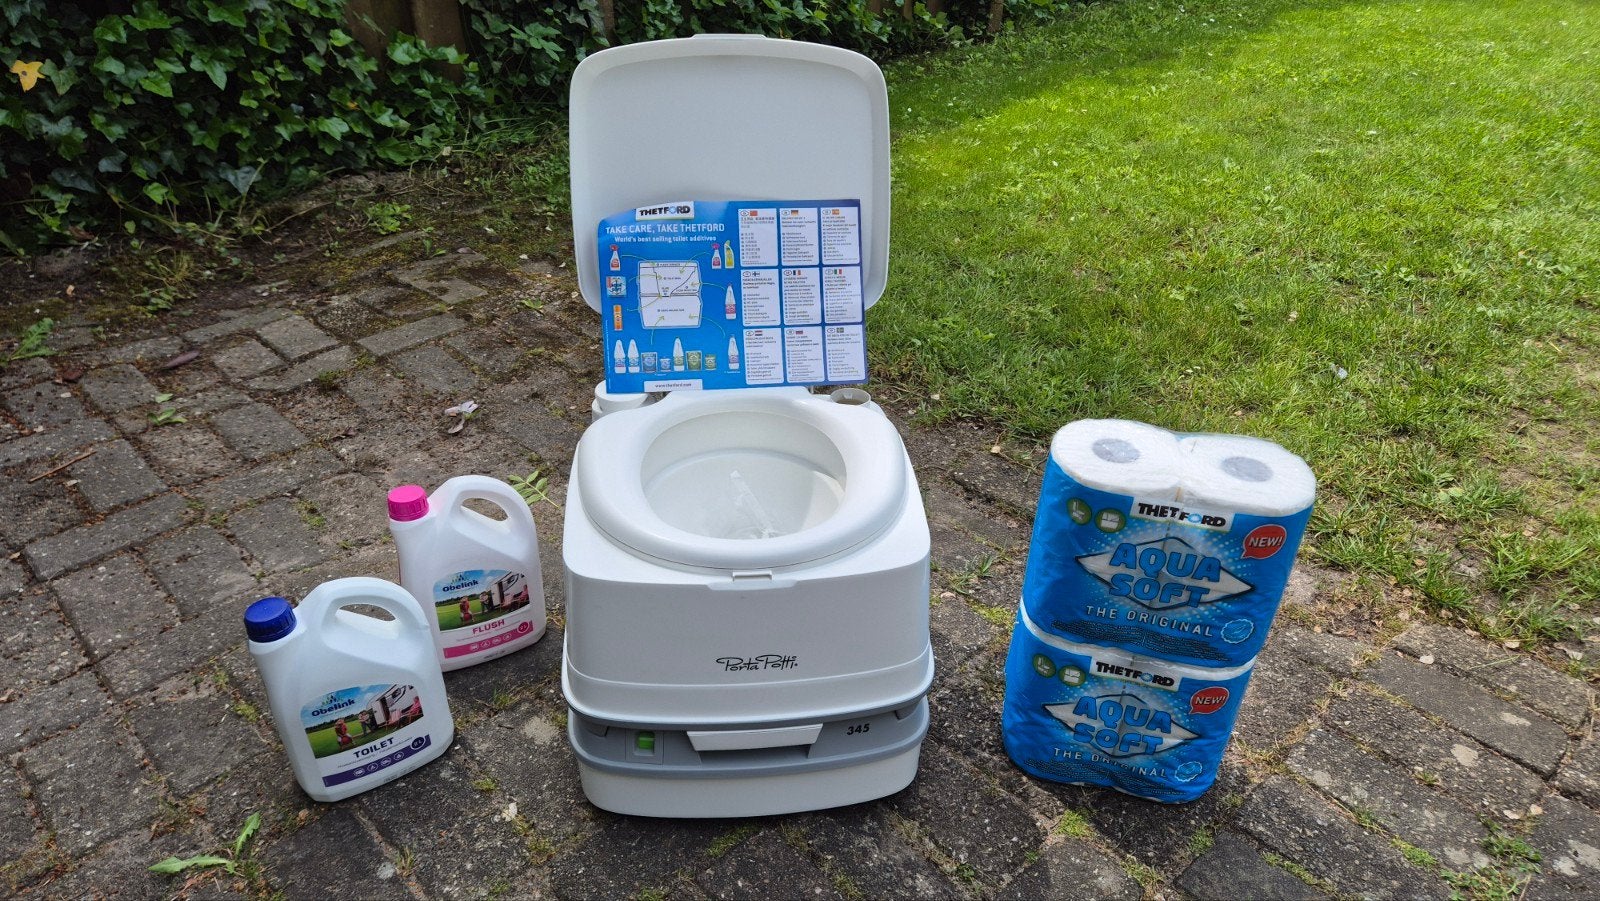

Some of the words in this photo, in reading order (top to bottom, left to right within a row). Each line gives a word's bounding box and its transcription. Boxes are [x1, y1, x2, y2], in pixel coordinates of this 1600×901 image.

[639, 205, 691, 216] THETFORD
[605, 226, 627, 235] TAKE
[629, 225, 655, 234] CARE,
[657, 224, 678, 233] TAKE
[680, 223, 725, 232] THETFORD
[652, 235, 672, 243] selling
[1138, 502, 1227, 528] THETFORD
[1249, 535, 1283, 548] NEW!
[1109, 542, 1221, 583] AQUA
[442, 580, 479, 592] Obelink
[1109, 573, 1211, 608] SOFT
[472, 619, 505, 634] FLUSH
[1086, 605, 1119, 620] THE
[1127, 610, 1213, 637] ORIGINAL
[716, 656, 759, 671] Porta
[1096, 661, 1175, 687] THETFORD
[311, 699, 356, 717] Obelink
[1195, 695, 1226, 706] NEW!
[1072, 695, 1172, 734] AQUA
[846, 723, 870, 736] 345
[1073, 722, 1164, 755] SOFT
[353, 737, 395, 758] TOILET
[1054, 747, 1082, 761] THE
